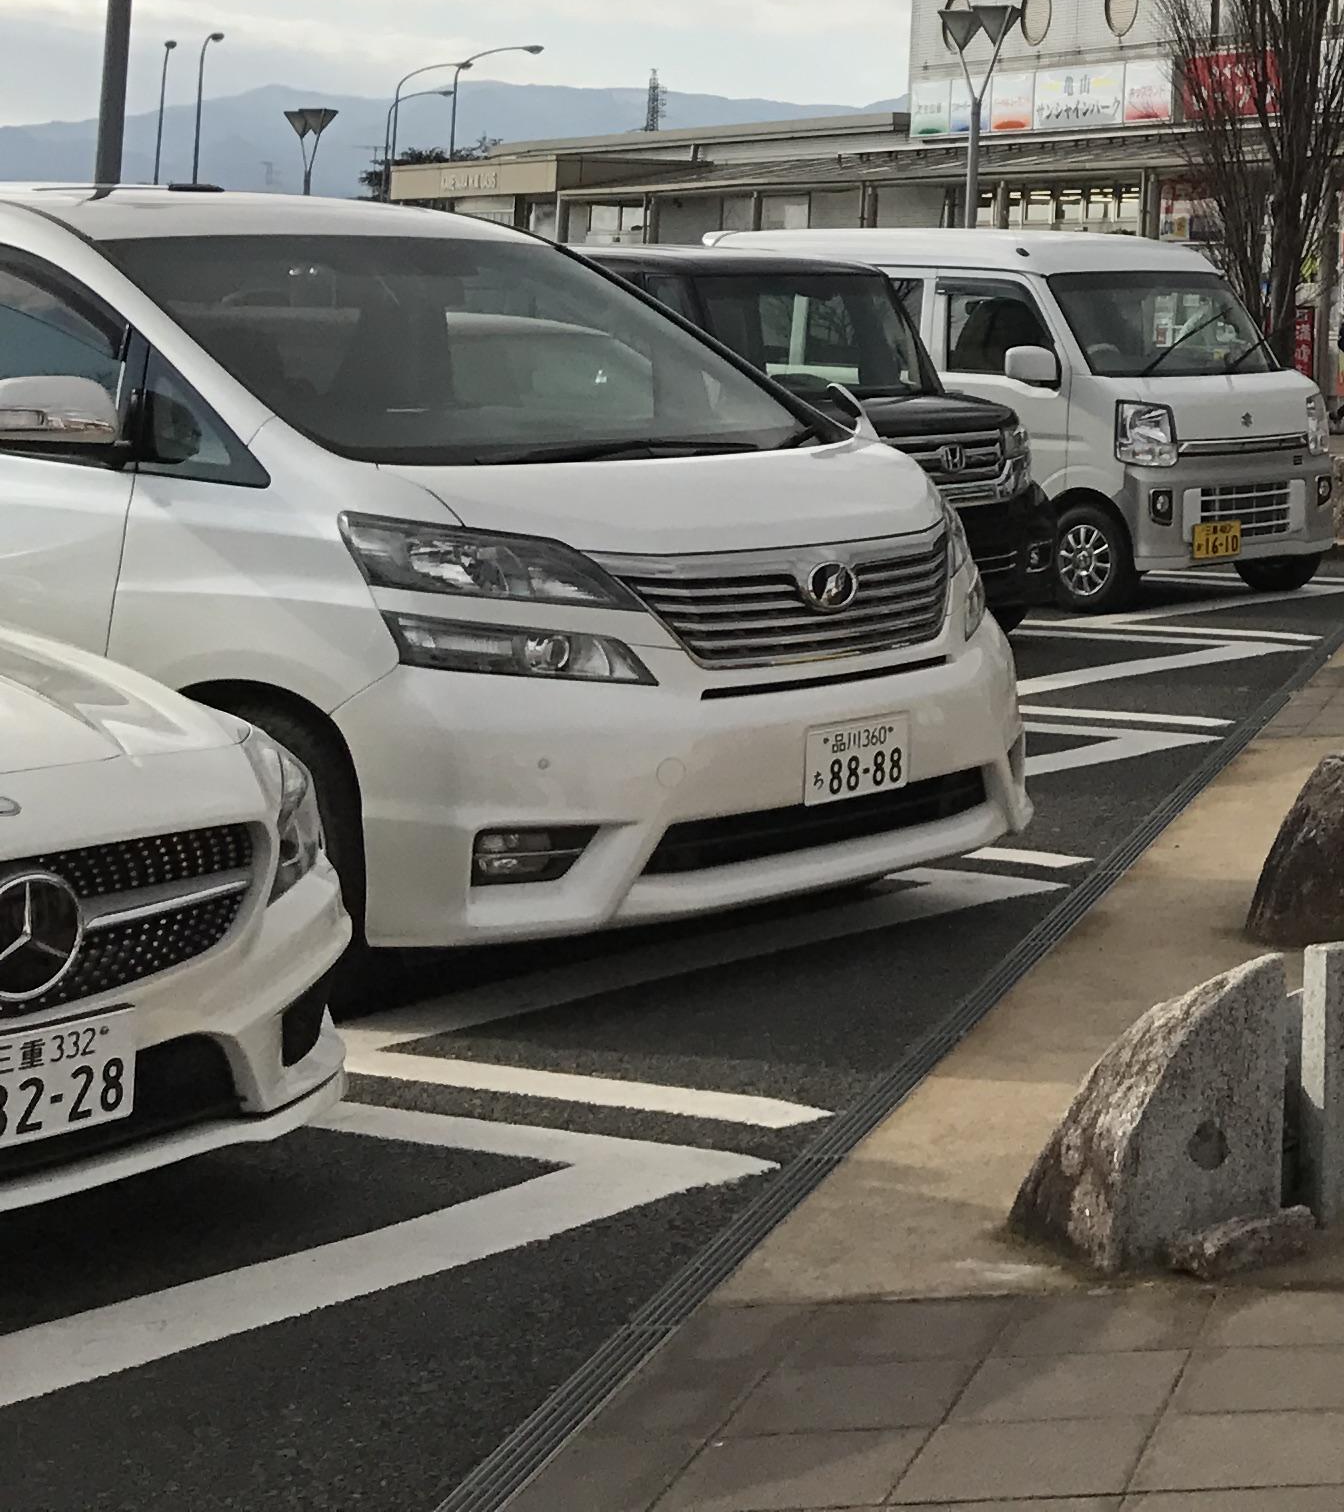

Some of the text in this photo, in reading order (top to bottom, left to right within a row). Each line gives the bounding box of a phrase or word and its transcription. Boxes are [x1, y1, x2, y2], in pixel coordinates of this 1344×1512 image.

[1064, 74, 1091, 96] 亀山
[832, 726, 887, 753] 品川360
[829, 747, 902, 795] 88-88
